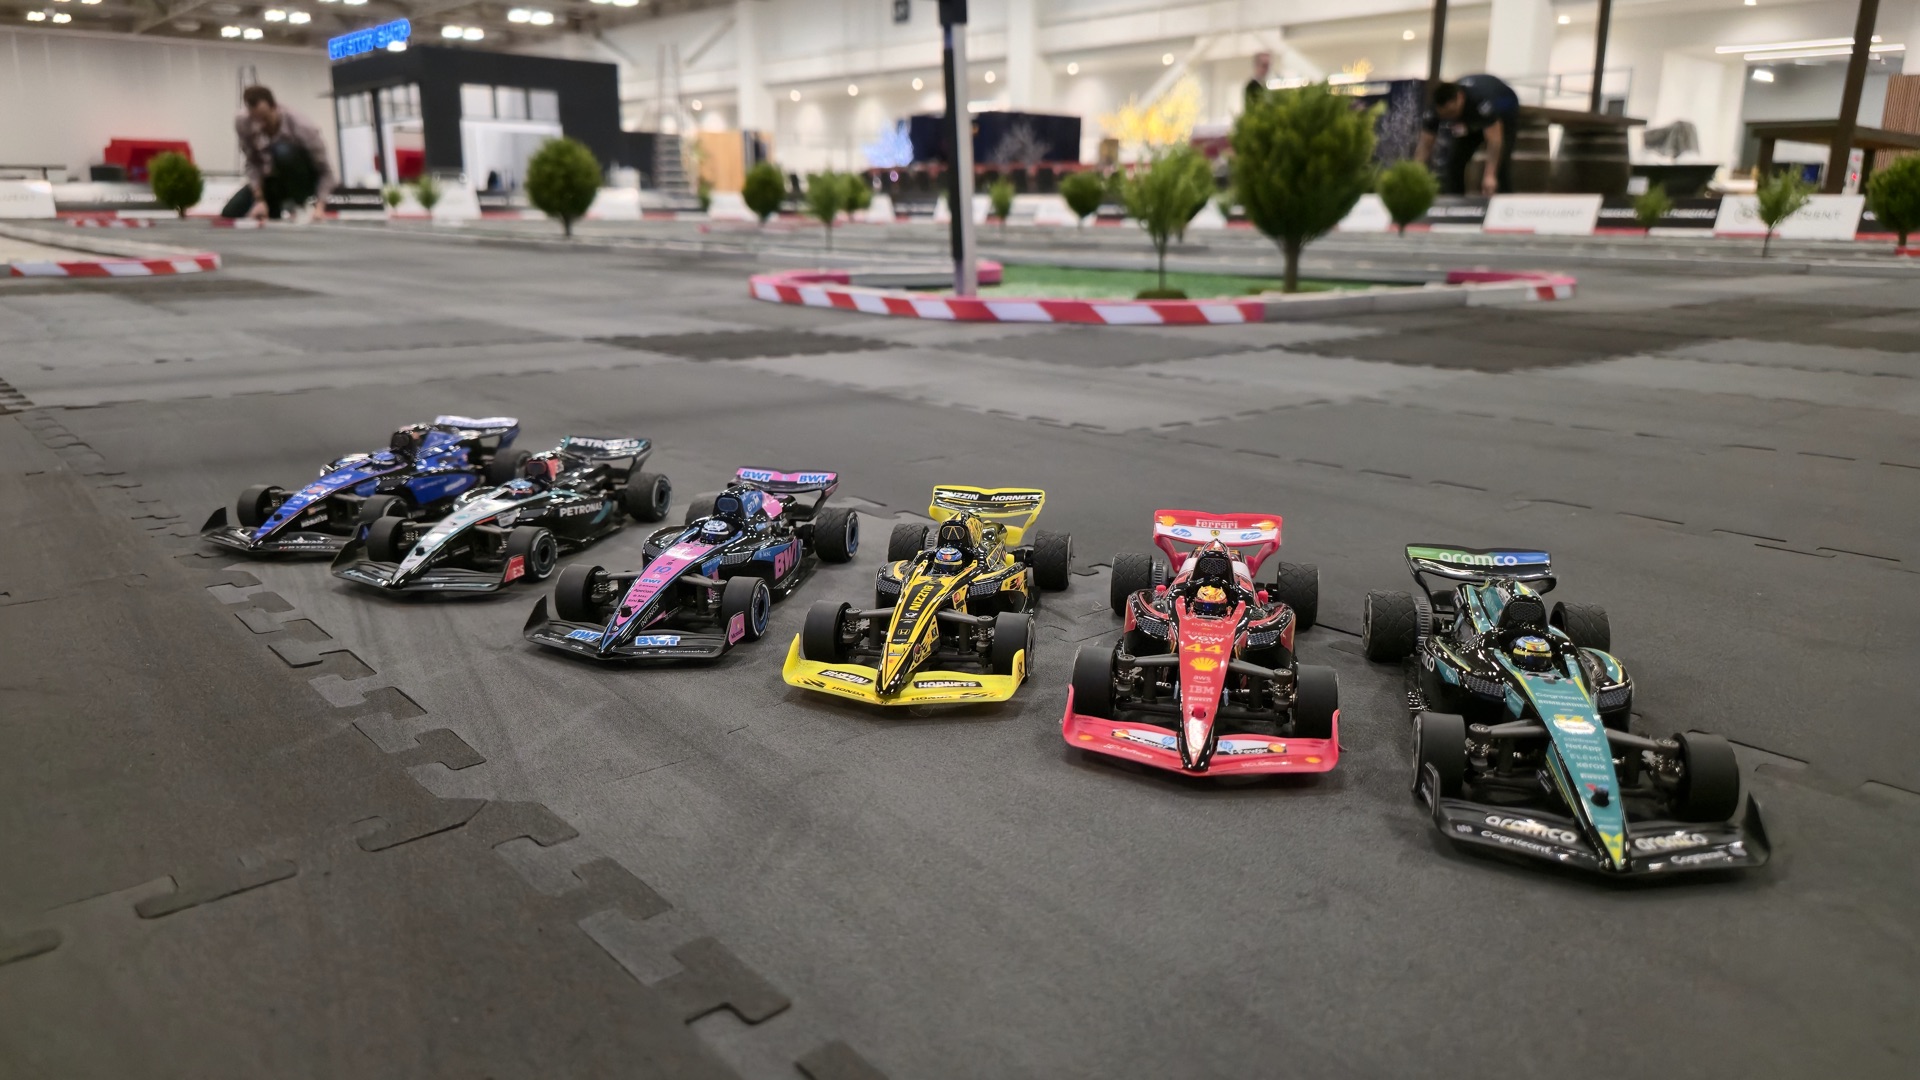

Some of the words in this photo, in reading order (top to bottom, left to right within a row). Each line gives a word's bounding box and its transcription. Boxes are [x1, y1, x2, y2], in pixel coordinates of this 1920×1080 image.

[570, 437, 639, 451] PETRONAS
[741, 469, 772, 482] BWT
[799, 474, 829, 484] BWT
[560, 502, 603, 518] PETRONAS
[1195, 519, 1238, 529] Ferrari
[1439, 552, 1518, 567] aramco
[653, 565, 671, 574] 10
[909, 584, 935, 611] BUZZIN
[640, 603, 660, 627] INFINOX
[566, 630, 601, 643] BWT
[636, 634, 680, 646] BWT
[1184, 643, 1225, 655] 44
[822, 670, 868, 684] BUZZIN
[832, 686, 865, 697] HONDA
[1189, 685, 1214, 695] IBM
[1565, 743, 1602, 752] NetApp
[1576, 761, 1607, 770] xerox
[1485, 815, 1578, 844] aramco
[1480, 829, 1551, 854] Cognizant
[1635, 833, 1709, 850] aramco
